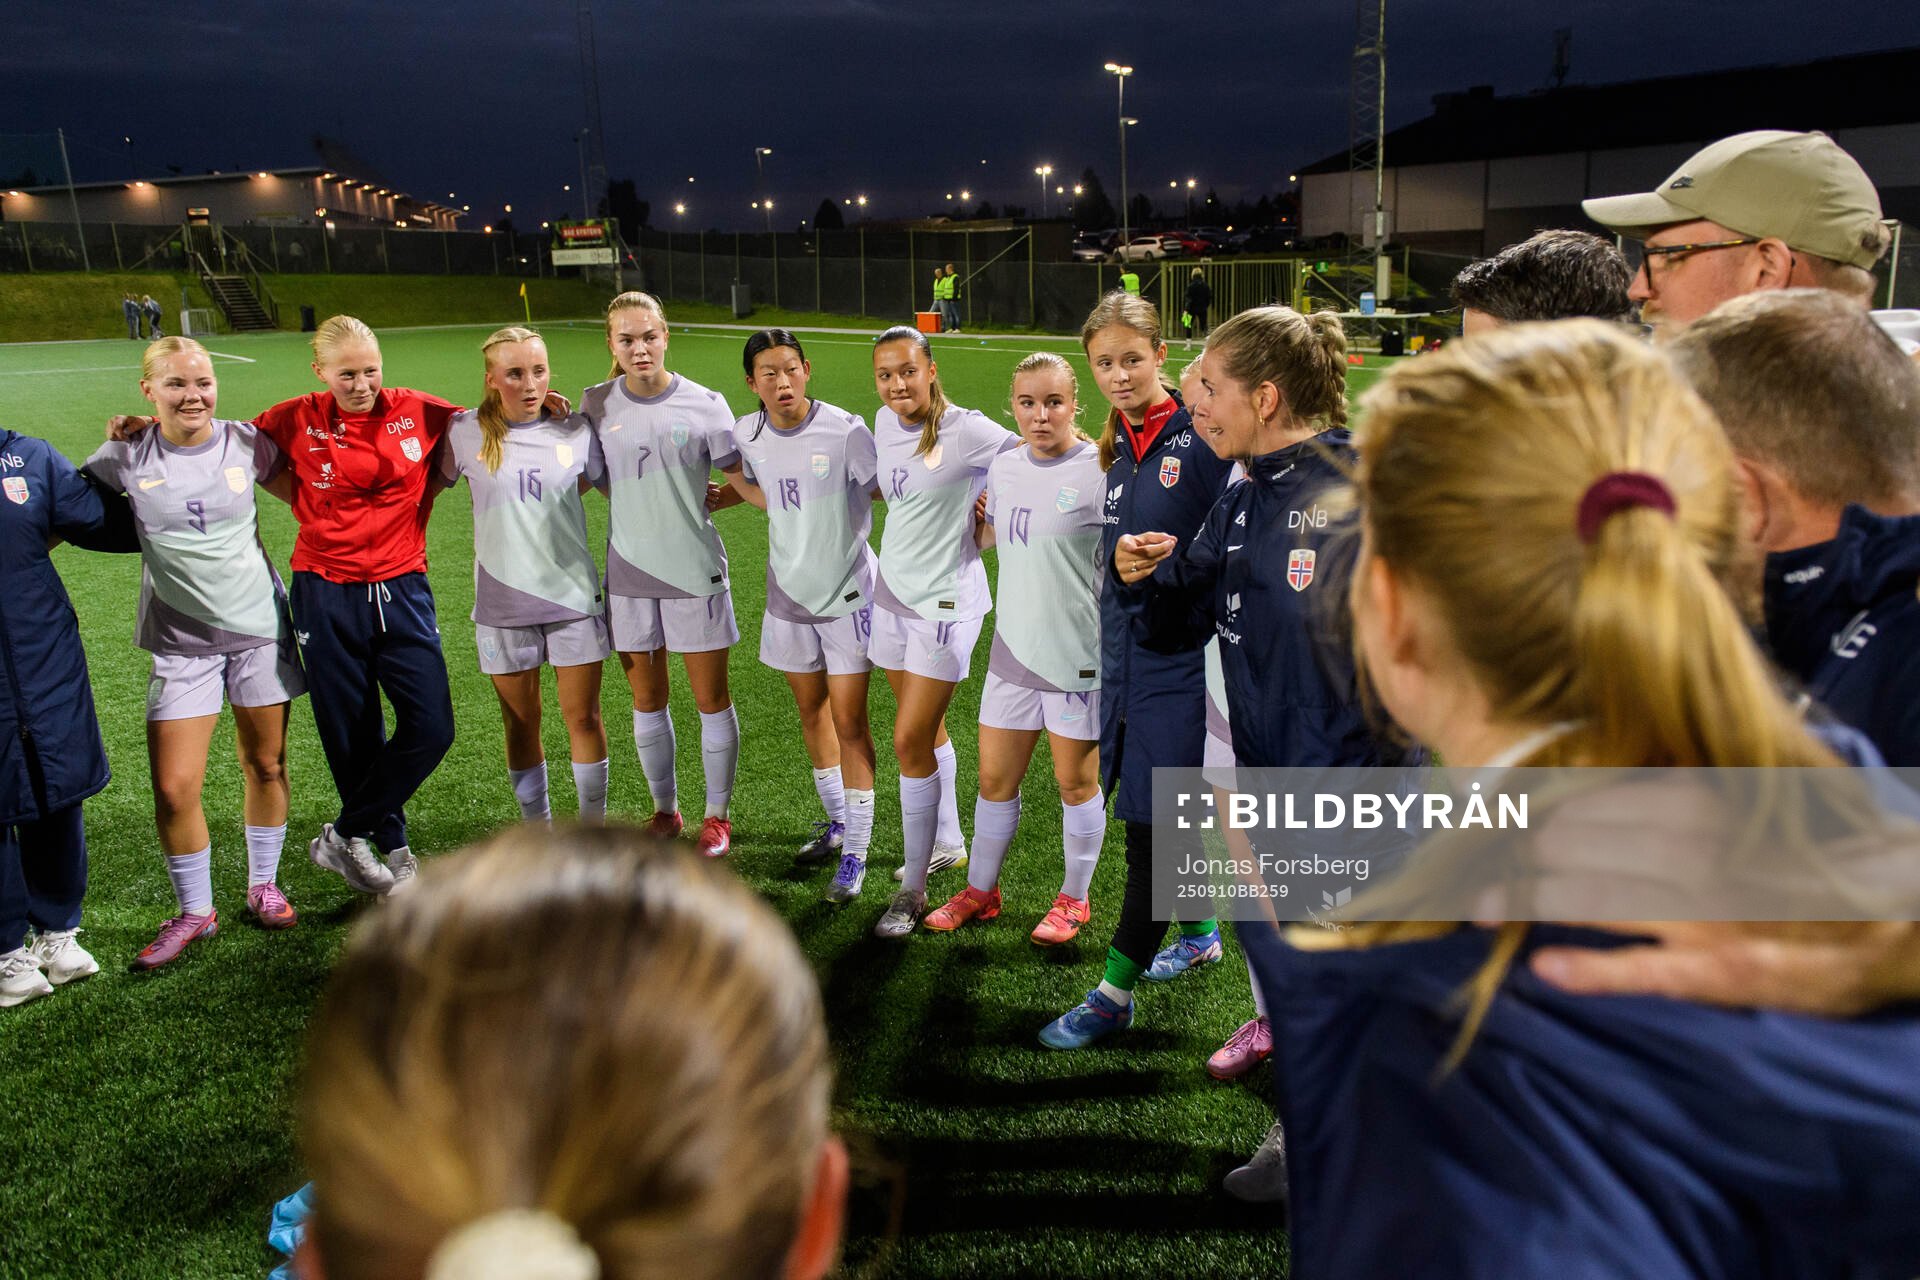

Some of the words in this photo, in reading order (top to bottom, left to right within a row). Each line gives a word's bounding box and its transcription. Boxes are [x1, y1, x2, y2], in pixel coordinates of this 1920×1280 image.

[386, 416, 415, 435] DNB
[0, 452, 25, 472] NB
[637, 446, 651, 480] 7
[517, 468, 542, 503] 16
[778, 478, 801, 511] 18
[892, 467, 909, 501] 17
[186, 500, 207, 535] 9
[1288, 504, 1328, 534] DNB
